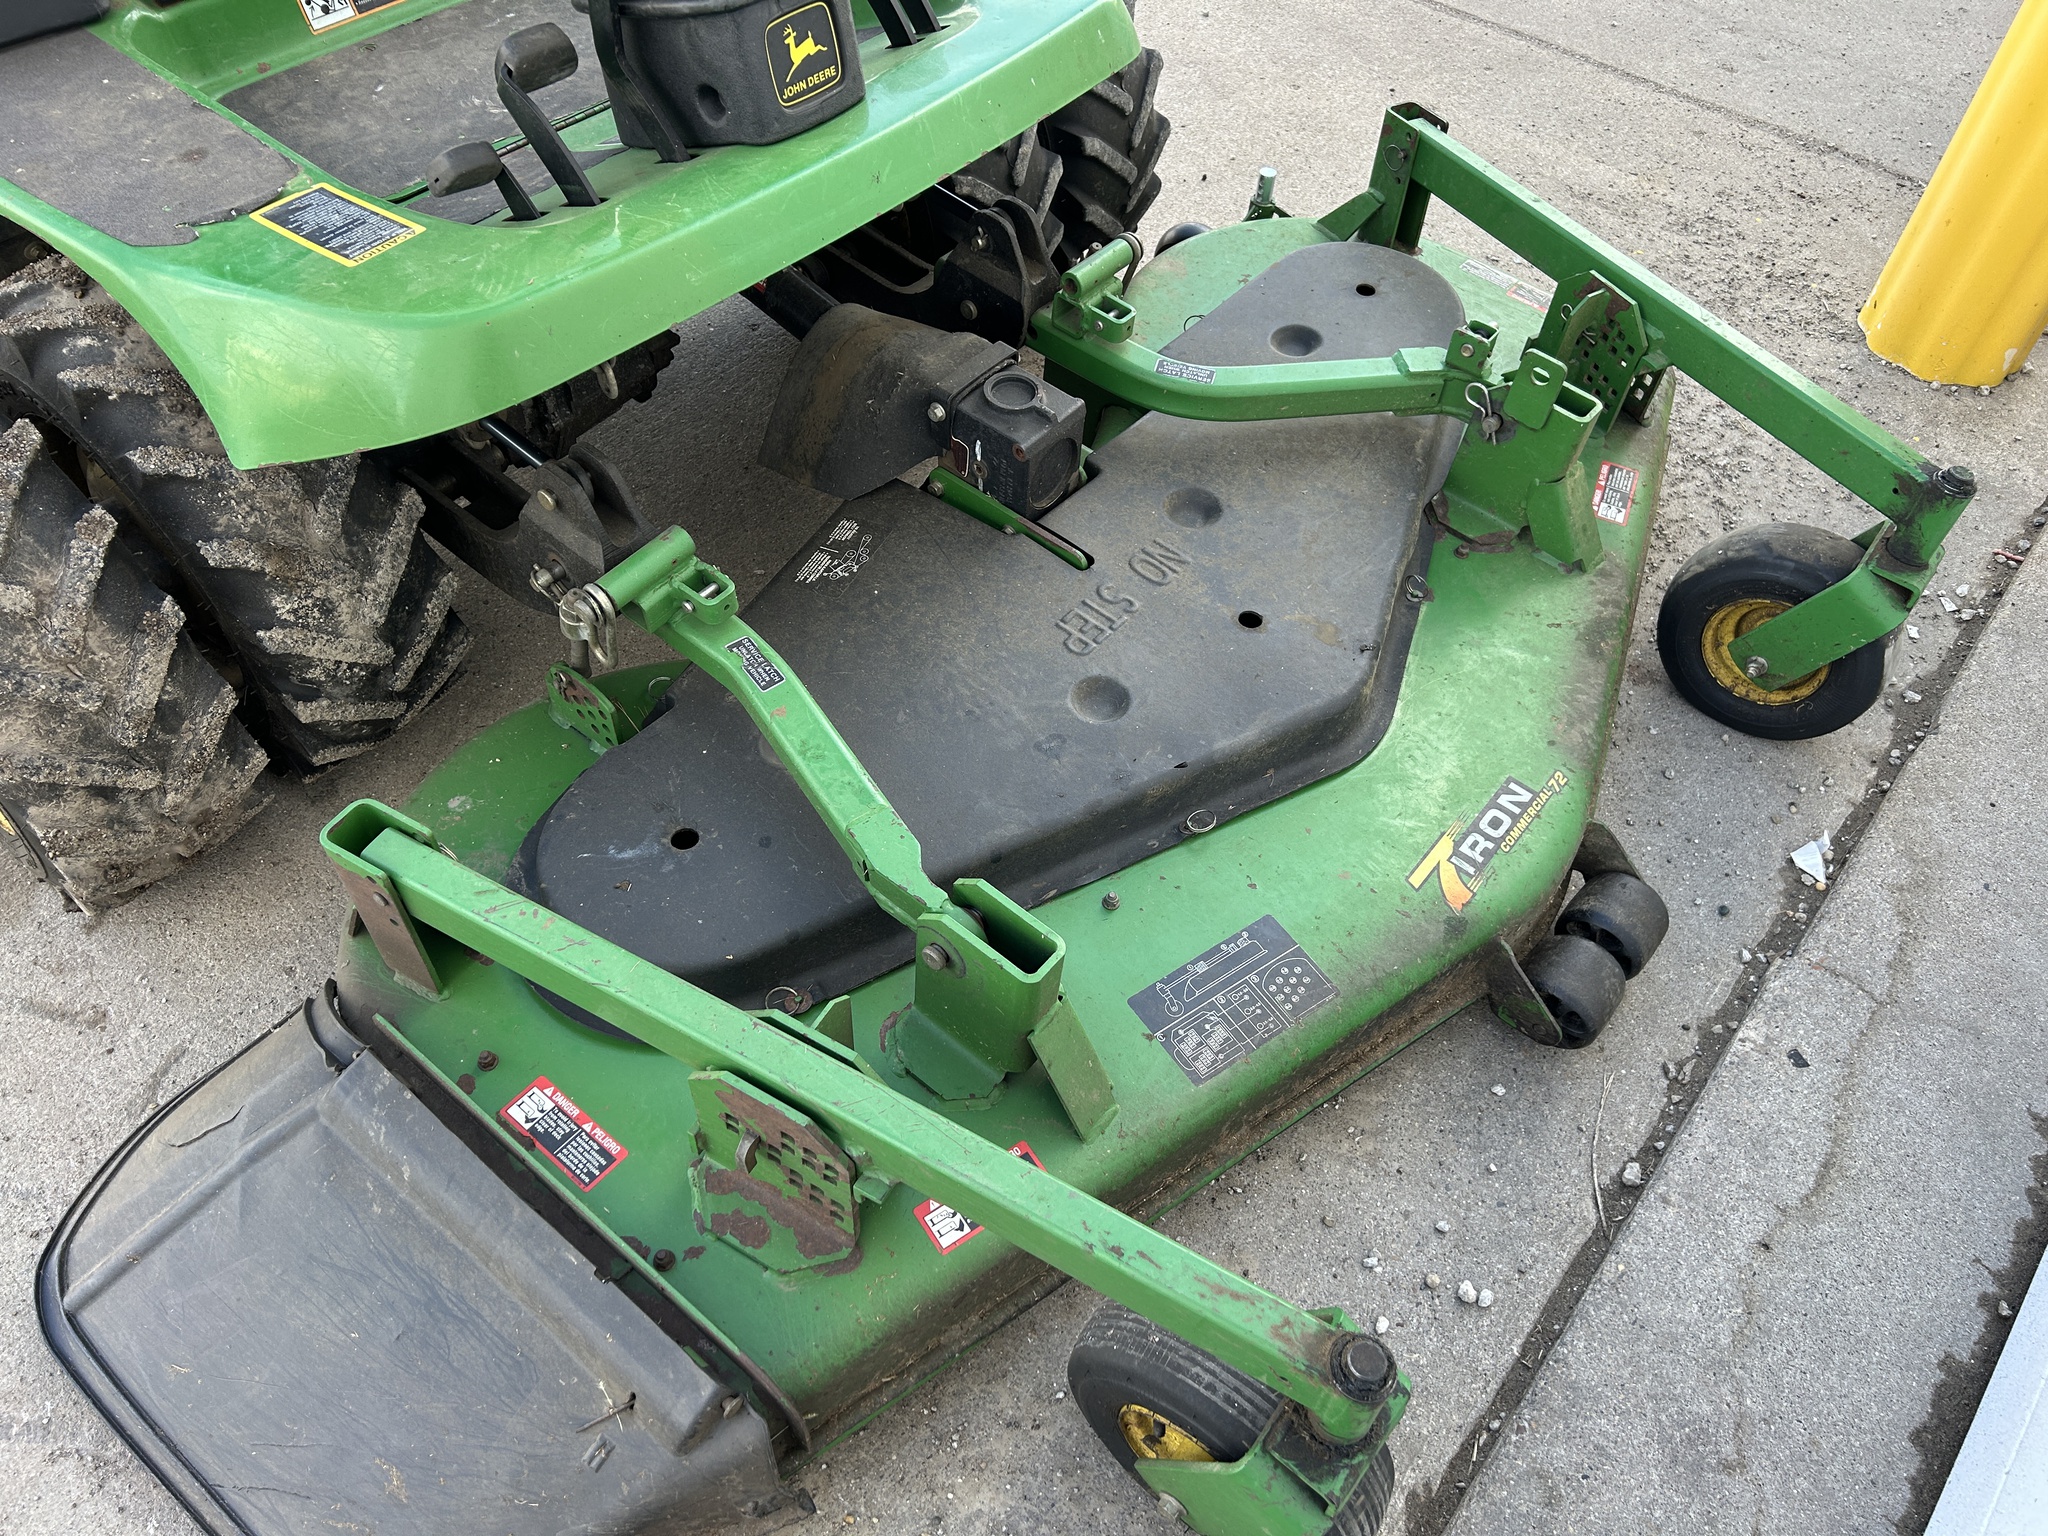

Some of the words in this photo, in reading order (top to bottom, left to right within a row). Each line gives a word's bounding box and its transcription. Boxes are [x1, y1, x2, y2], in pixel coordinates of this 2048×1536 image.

[783, 79, 807, 99] JOHN
[807, 65, 837, 87] DEERE
[351, 234, 409, 263] CAUTION
[1158, 368, 1180, 376] LATCH
[1128, 538, 1193, 586] NO
[1055, 582, 1139, 656] STEP
[742, 638, 764, 662] SERVICE
[762, 662, 781, 682] LATCH
[748, 666, 767, 686] VEHICLE
[757, 667, 771, 682] WHEN
[1500, 789, 1552, 853] COMMERCIAL
[1547, 770, 1568, 792] 72
[551, 1092, 580, 1117] DANGER
[557, 1112, 567, 1121] avoid
[580, 1132, 589, 1141] Para
[591, 1128, 621, 1155] PELIGRO
